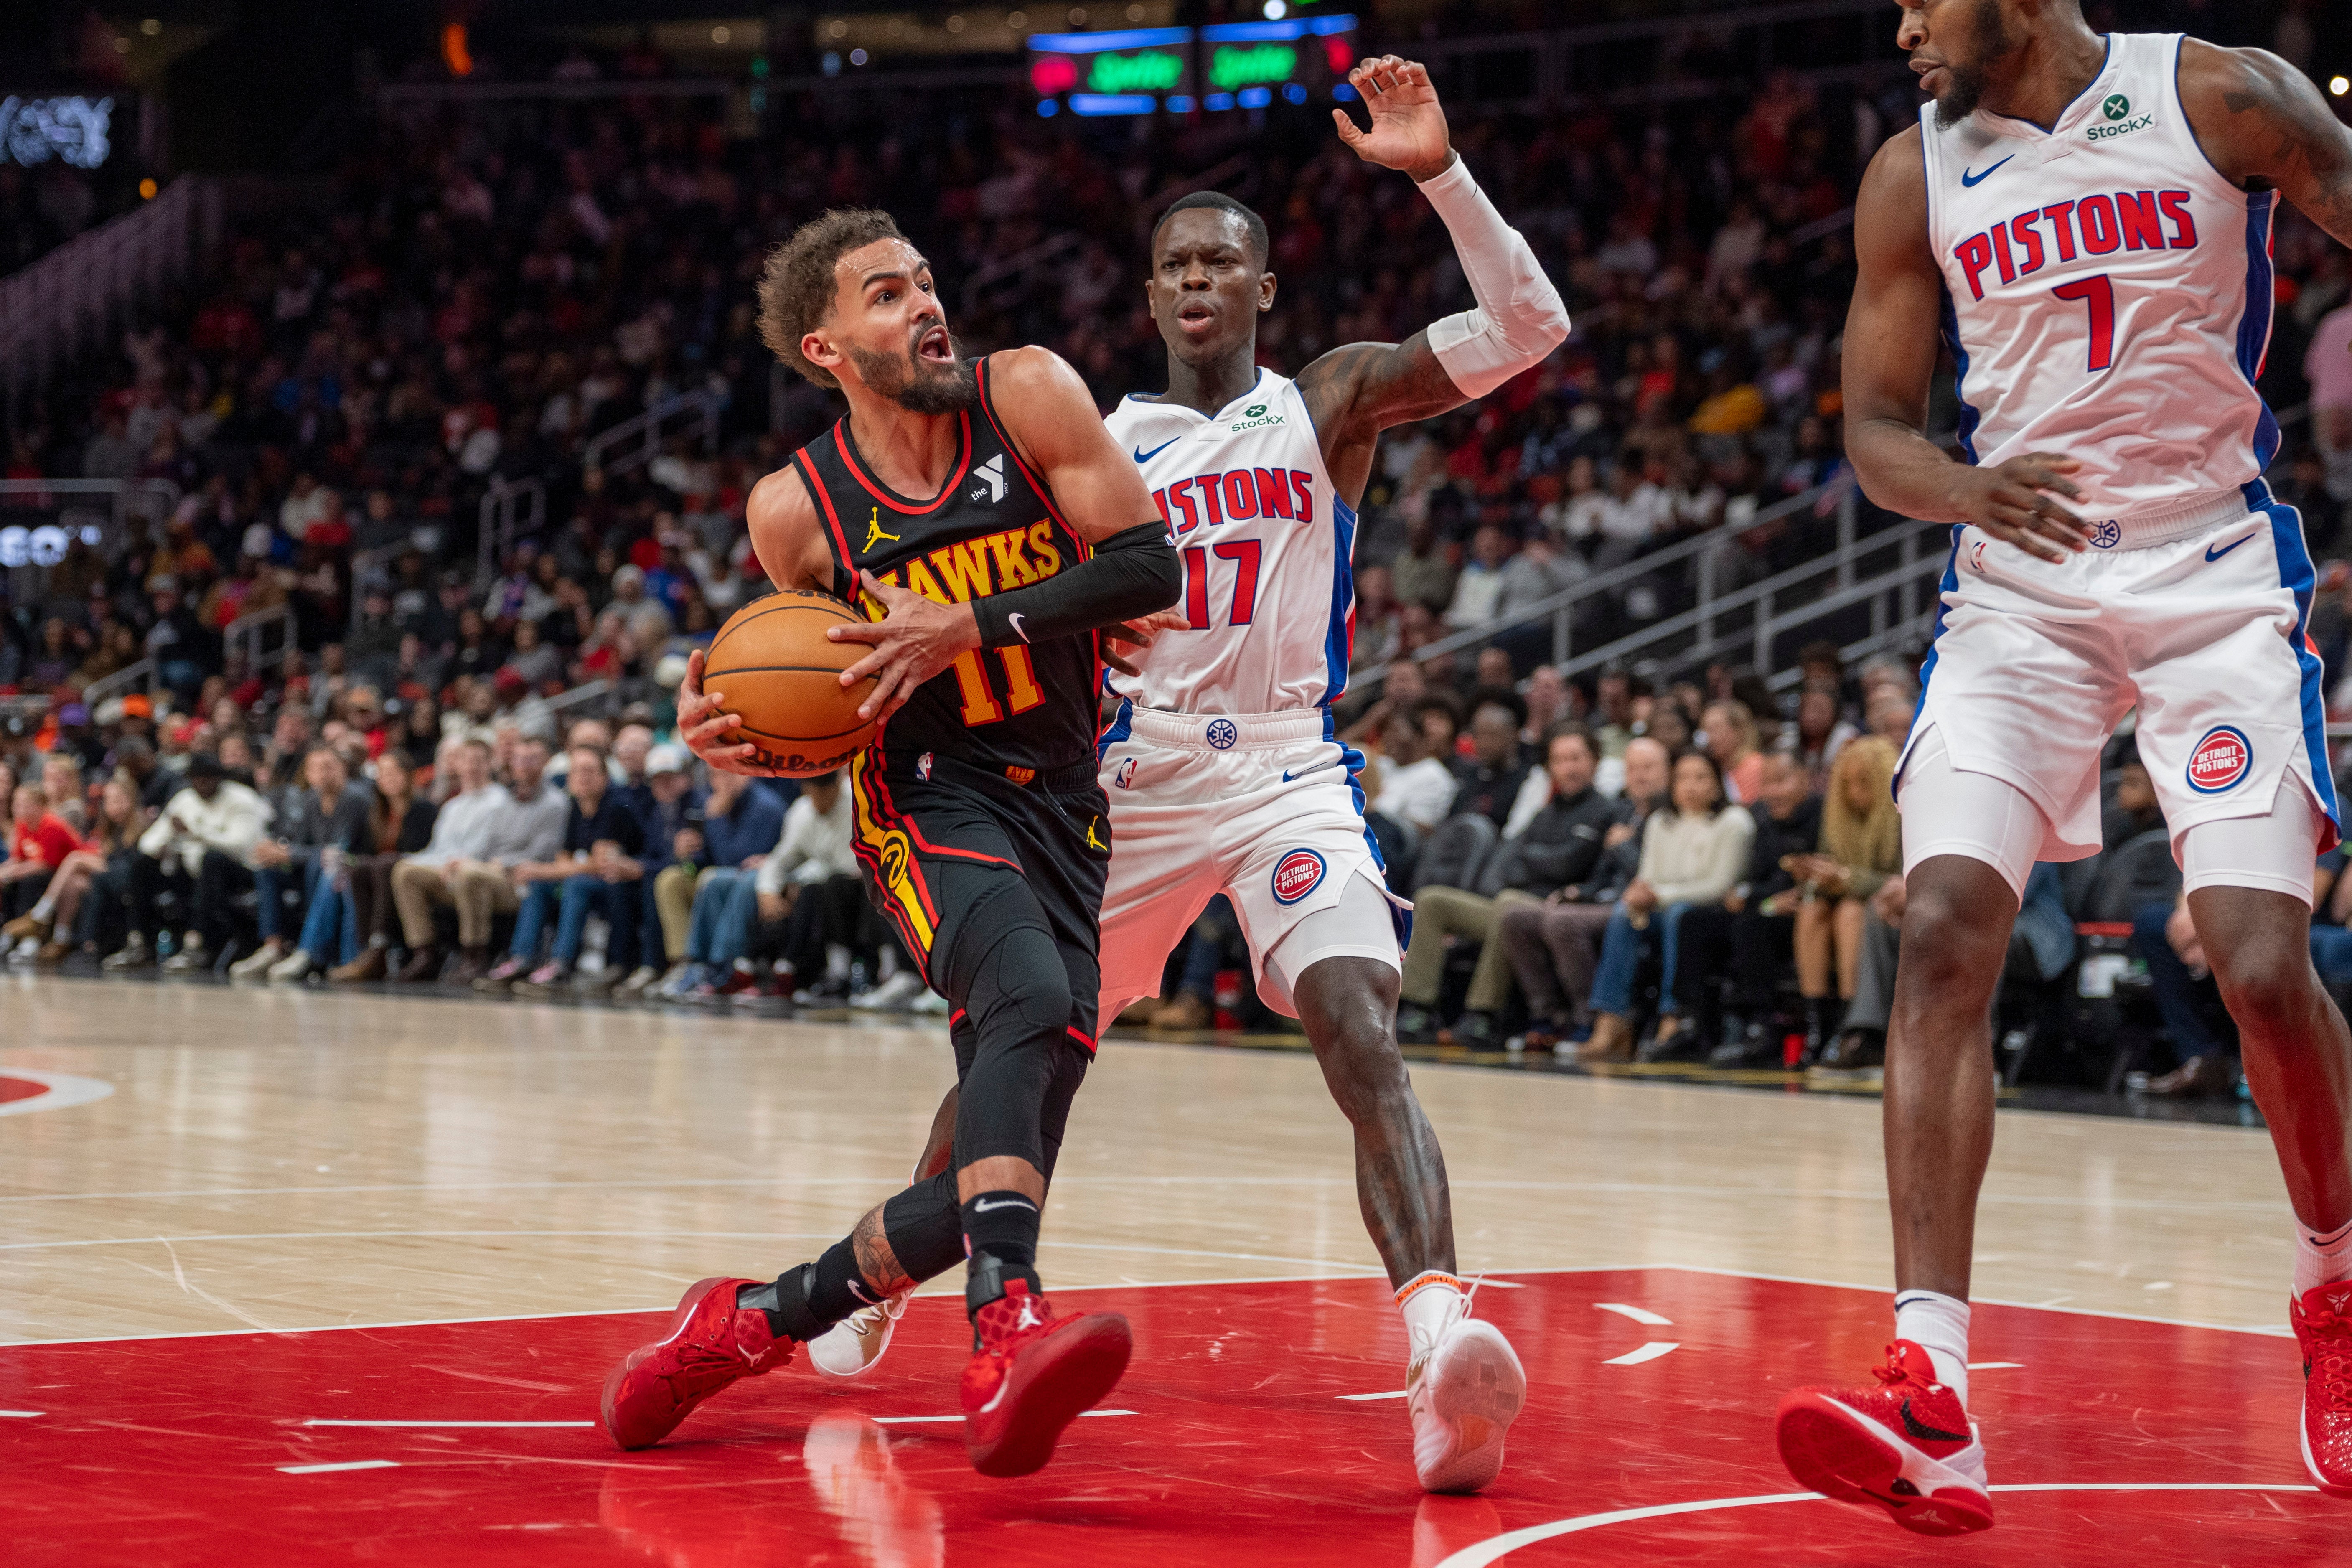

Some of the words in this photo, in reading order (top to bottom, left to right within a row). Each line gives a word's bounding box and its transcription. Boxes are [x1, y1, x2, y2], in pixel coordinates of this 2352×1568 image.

[2087, 113, 2153, 140] StockX
[1954, 190, 2198, 302] PISTONS
[2051, 273, 2115, 373] 7
[1231, 415, 1285, 432] StockX
[971, 488, 987, 501] the
[1152, 467, 1312, 539] ISTONS
[1183, 539, 1262, 630] 17
[948, 644, 1046, 728] 11
[2197, 745, 2237, 763] DETROIT
[1008, 766, 1030, 780] ATL
[2196, 757, 2238, 774] PISTONS
[1280, 862, 1314, 882] DETROIT
[1281, 870, 1314, 891] PISTONS
